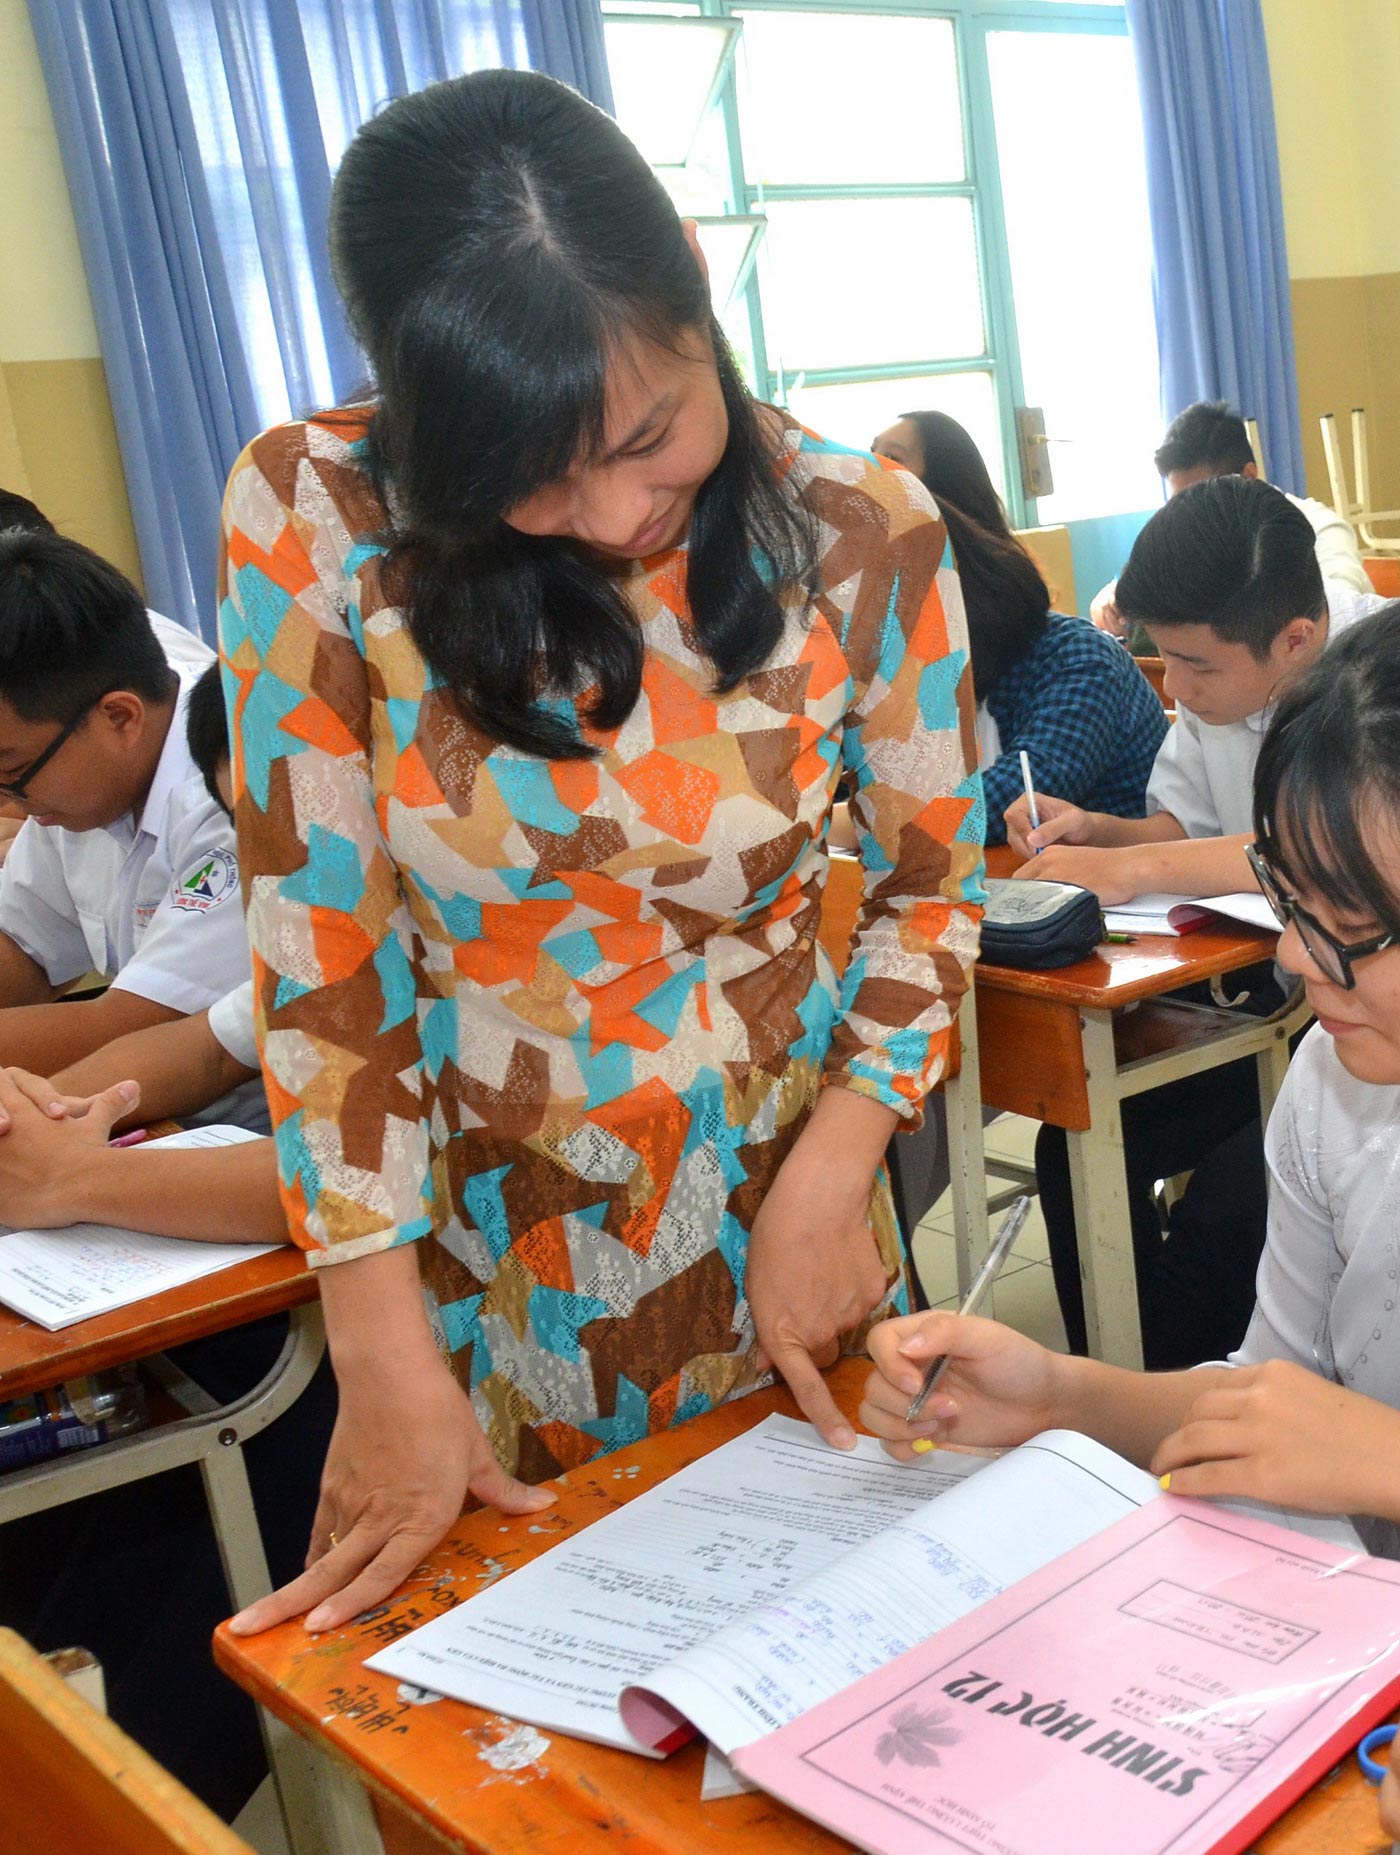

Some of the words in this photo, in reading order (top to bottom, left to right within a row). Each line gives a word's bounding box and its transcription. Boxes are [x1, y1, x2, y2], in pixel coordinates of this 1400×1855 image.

[941, 1670, 1004, 1704] 12
[986, 1690, 1097, 1741] HỌC
[1081, 1729, 1211, 1796] SINH
